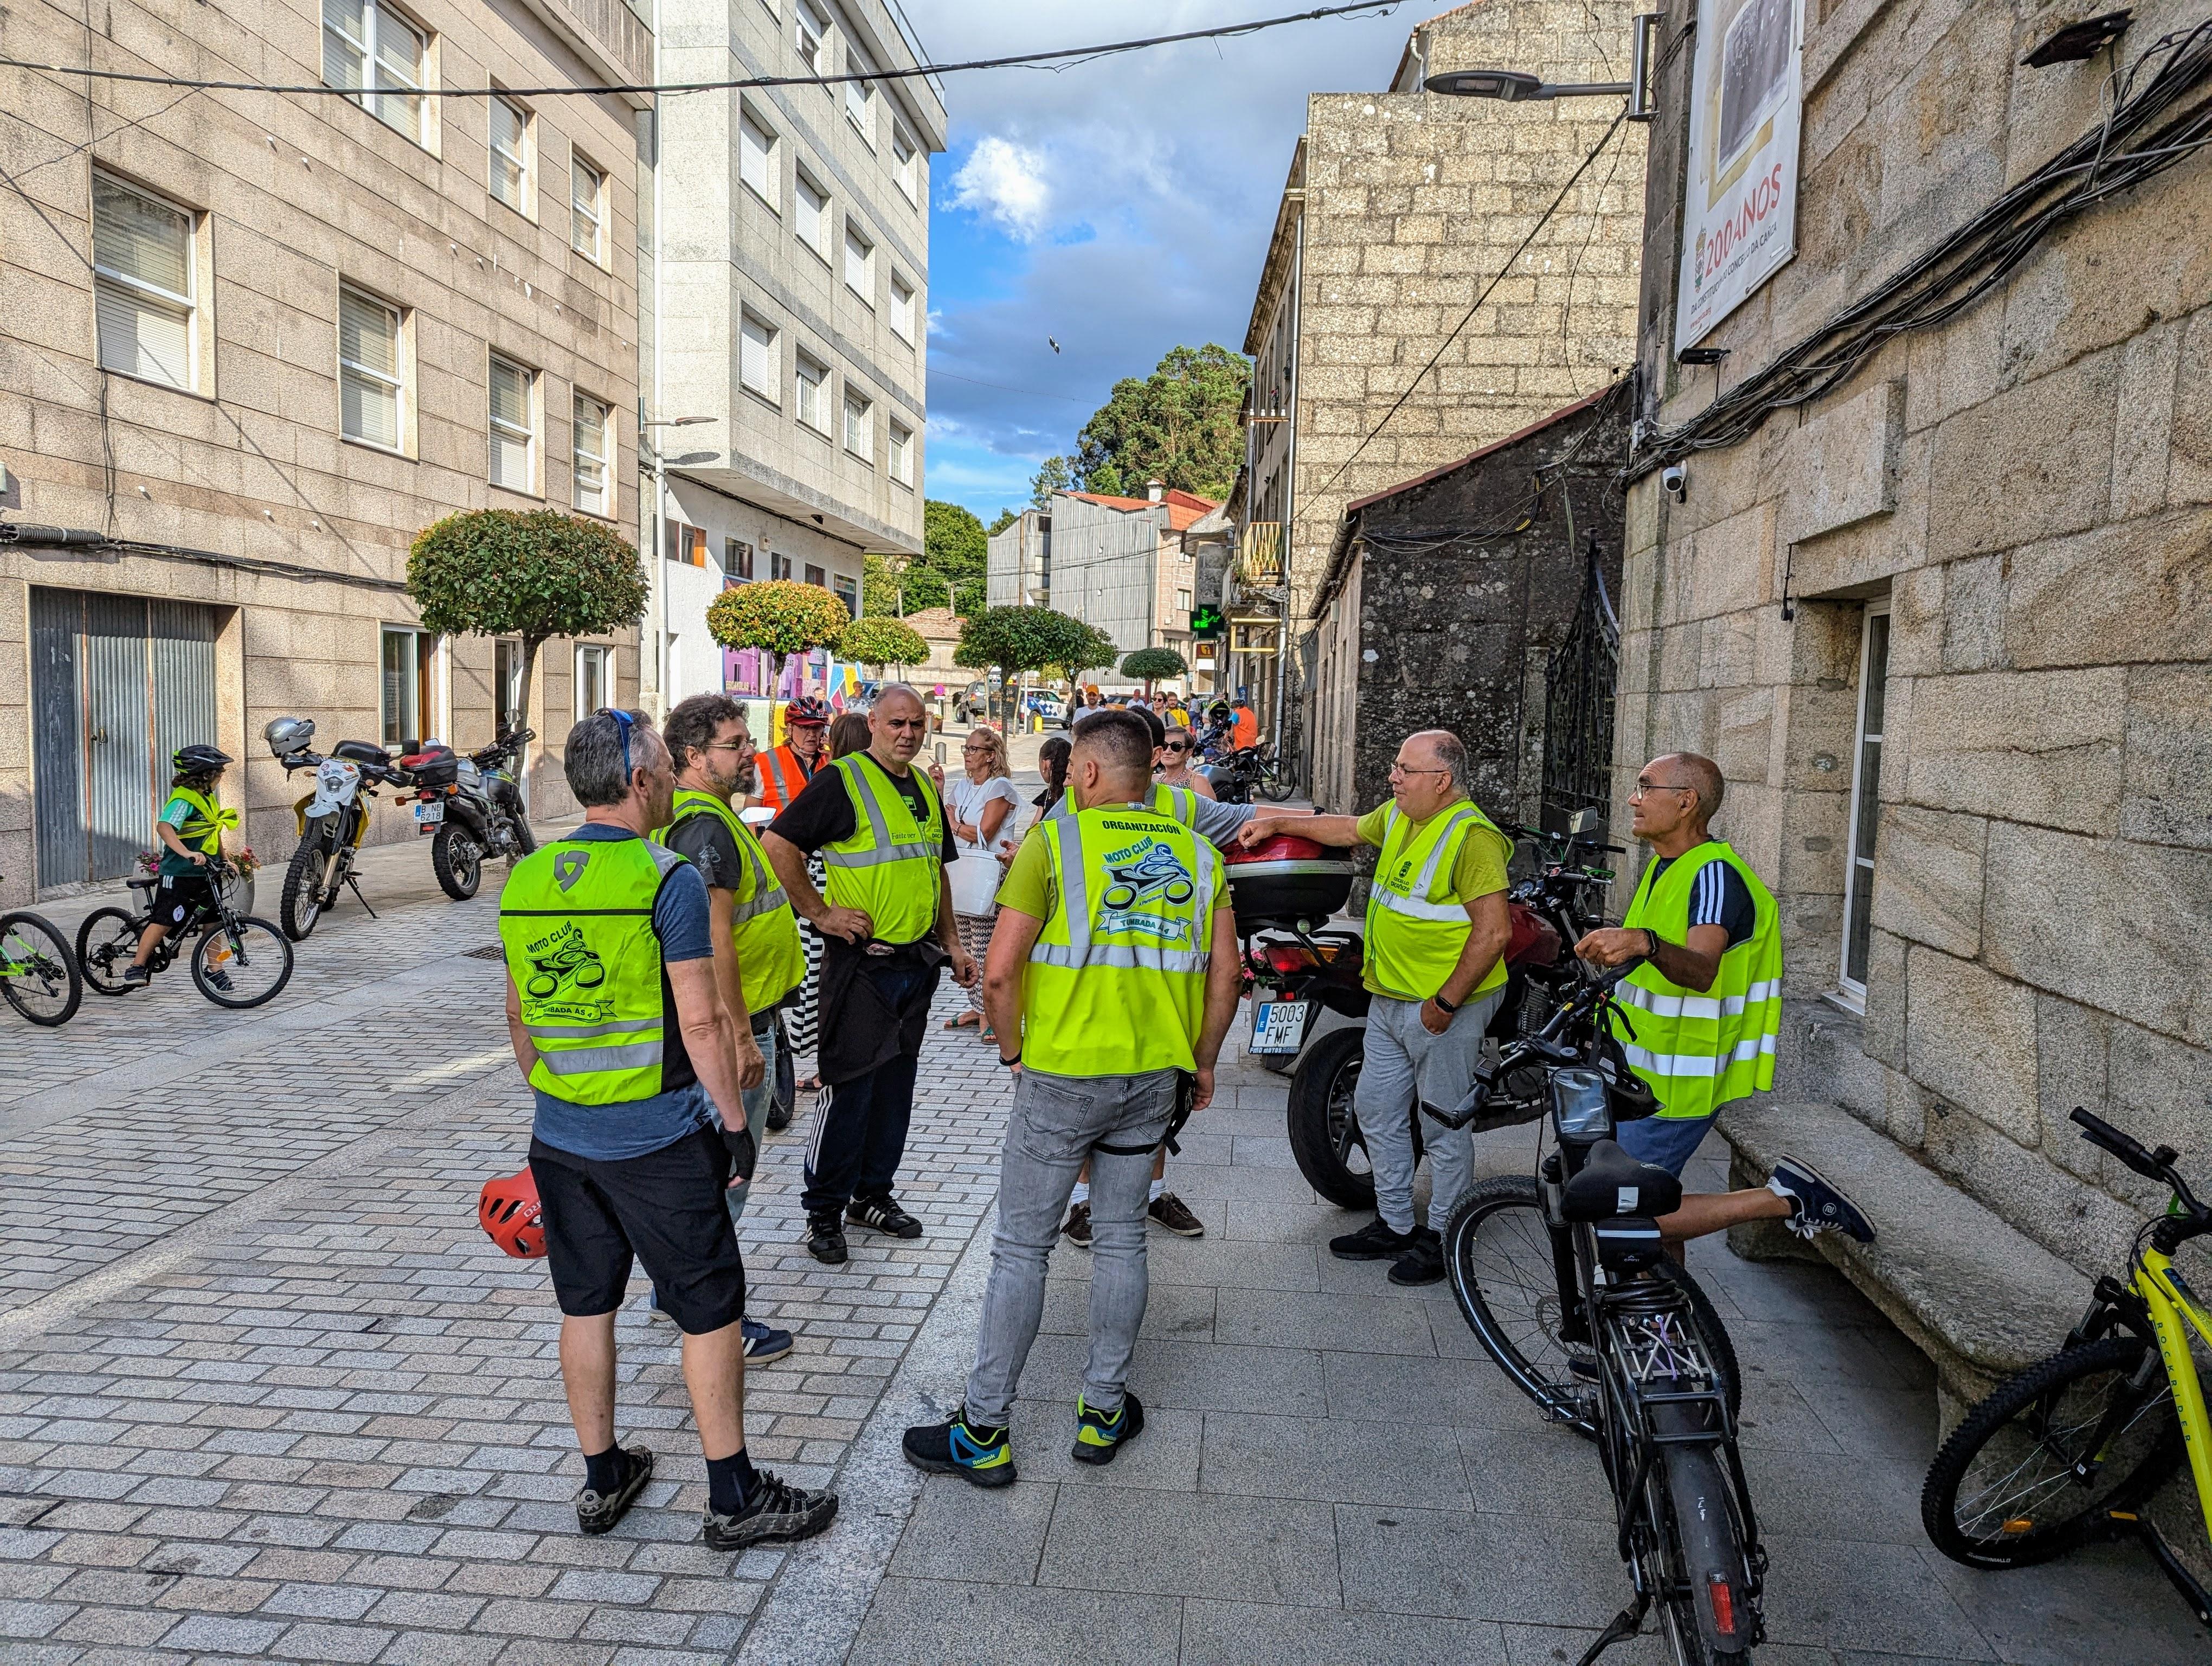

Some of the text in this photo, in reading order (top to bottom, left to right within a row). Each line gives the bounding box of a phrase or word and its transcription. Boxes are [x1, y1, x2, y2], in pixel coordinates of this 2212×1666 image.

[1751, 239, 1759, 254] DA
[421, 805, 426, 813] B
[421, 812, 441, 821] 6218
[1102, 820, 1181, 835] ORGANIZACIÓN
[1103, 835, 1154, 863] MOTO CLUB
[526, 920, 573, 953] MOTO CLUB
[1270, 1004, 1305, 1023] 5003
[1265, 1026, 1293, 1045] FMF
[2157, 1322, 2191, 1441] ROCKRIDER
[972, 1453, 996, 1465] Reebok
